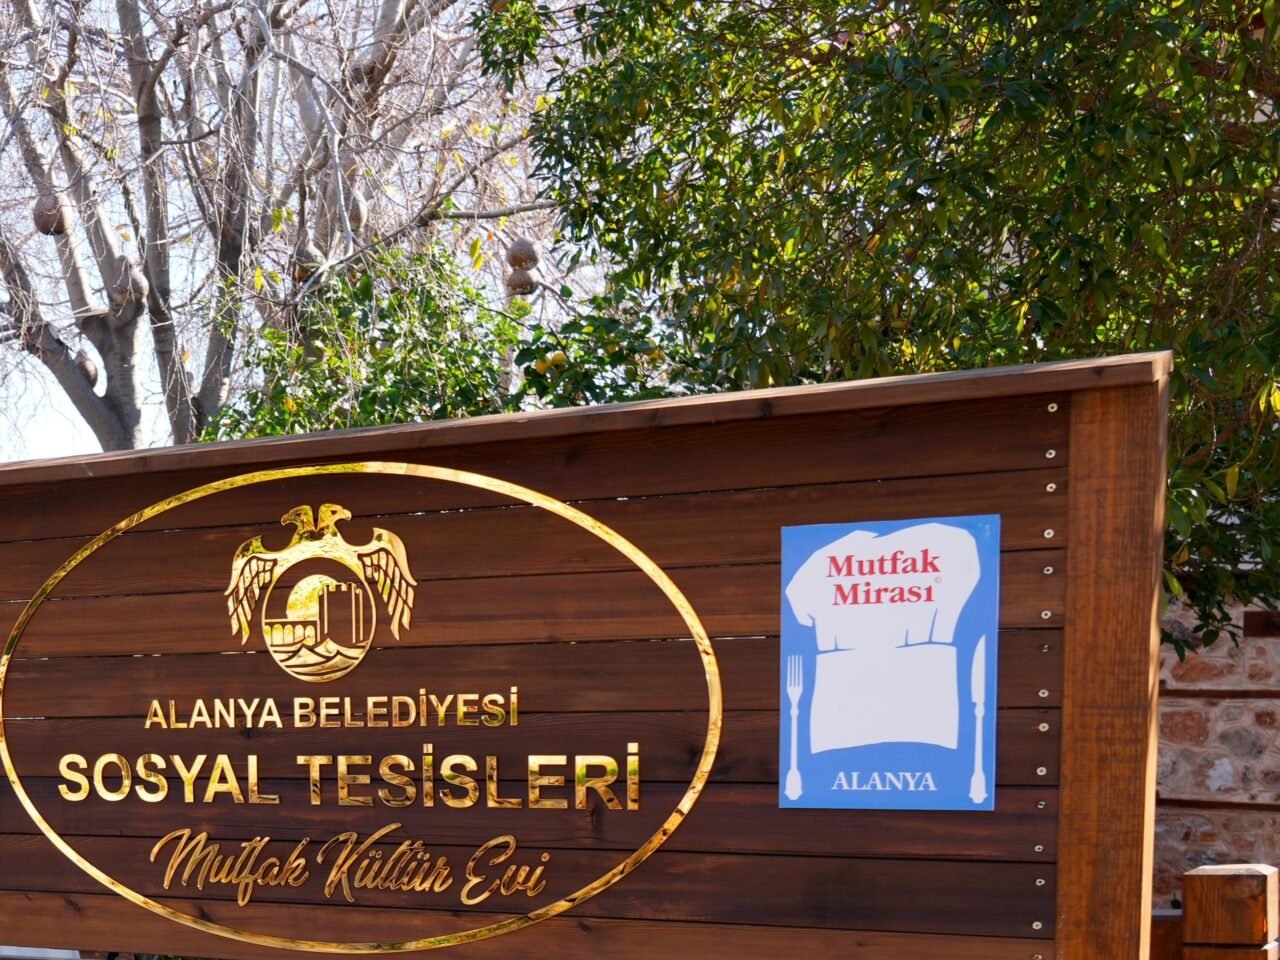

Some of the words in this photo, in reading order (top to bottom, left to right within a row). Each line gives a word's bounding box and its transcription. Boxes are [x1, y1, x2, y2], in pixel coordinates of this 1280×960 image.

[826, 549, 941, 578] Mutfak
[832, 581, 935, 606] Mirası
[144, 696, 283, 729] ALANYA
[293, 686, 518, 729] BELEDİYESİ
[57, 752, 280, 805] SOSYAL
[296, 742, 640, 811] TESİSLERİ
[831, 771, 938, 792] ALANYA
[150, 827, 310, 907] Mutfak
[317, 823, 453, 903] Kültür
[461, 834, 551, 905] Evi
